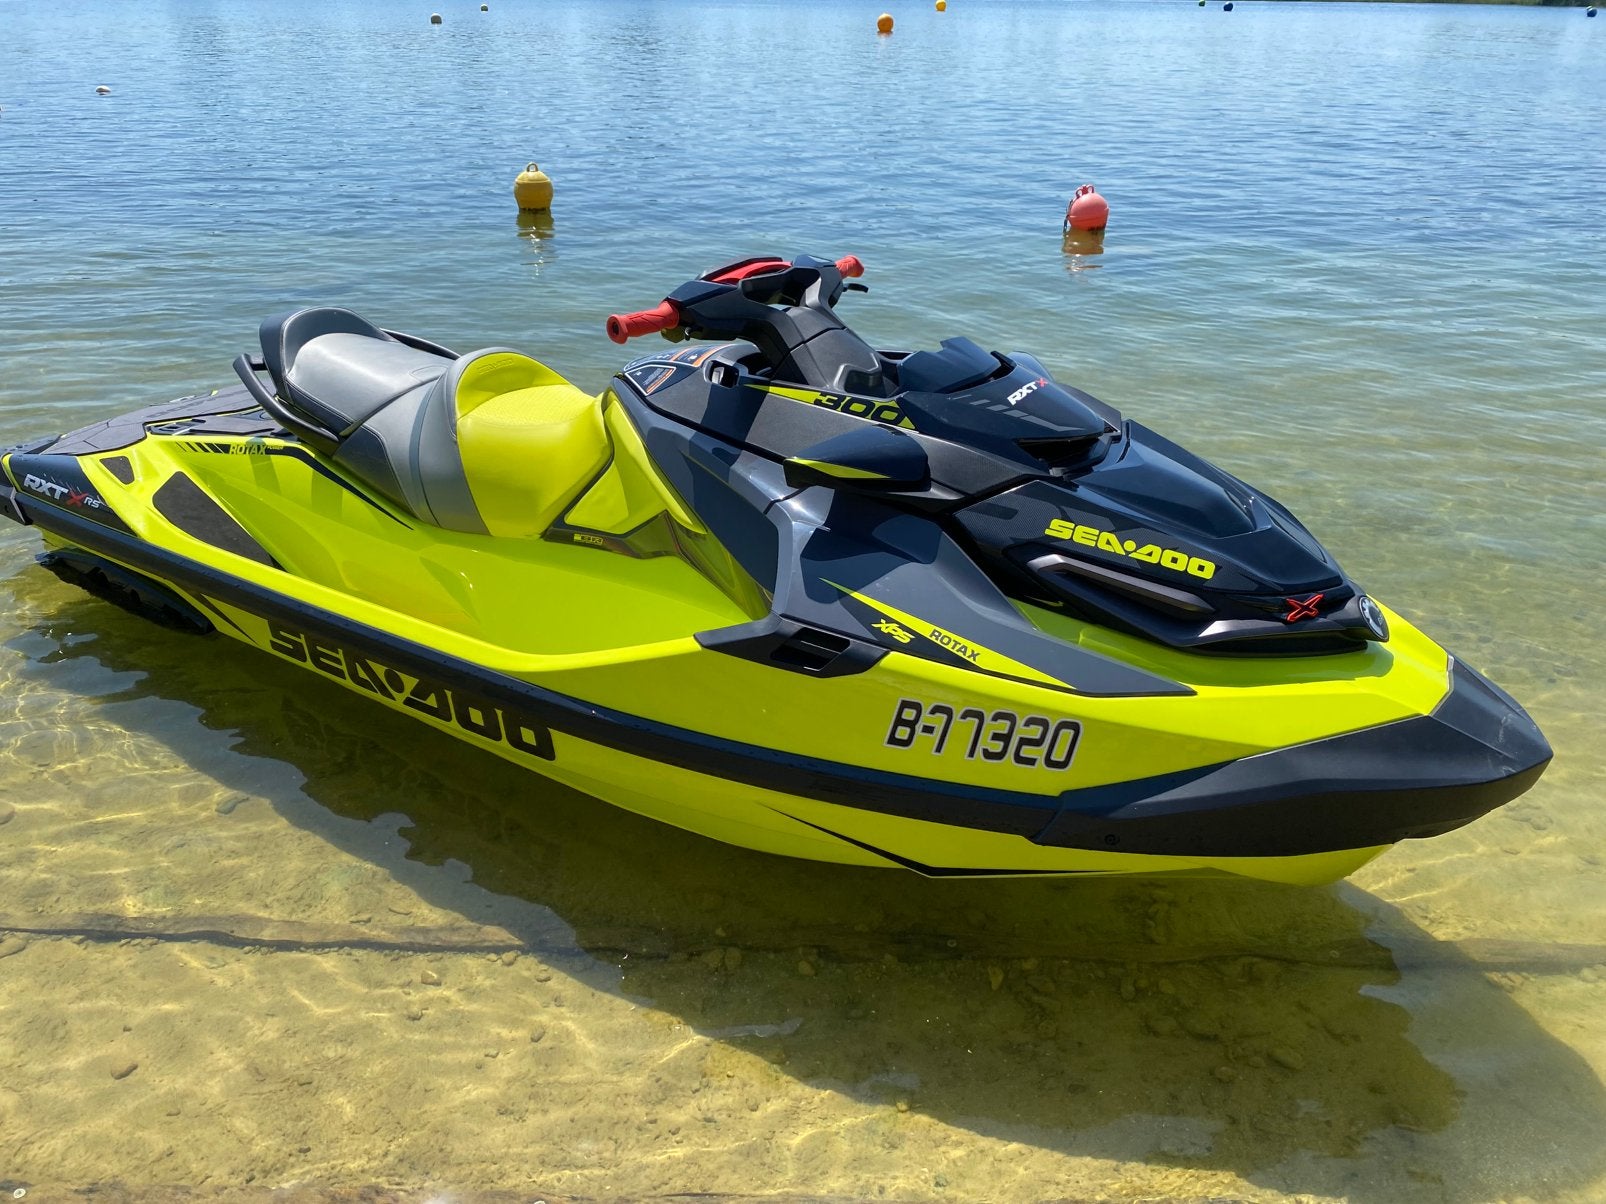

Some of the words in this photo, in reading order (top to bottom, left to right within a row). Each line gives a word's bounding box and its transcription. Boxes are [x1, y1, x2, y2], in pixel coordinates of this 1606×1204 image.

[813, 391, 903, 426] 300
[1006, 381, 1038, 406] RXT
[228, 443, 267, 456] ROTAX
[23, 473, 69, 500] RXT
[83, 496, 101, 509] RS
[871, 618, 916, 644] XPS
[928, 628, 981, 662] ROTAX
[884, 698, 1083, 771] B-77320
